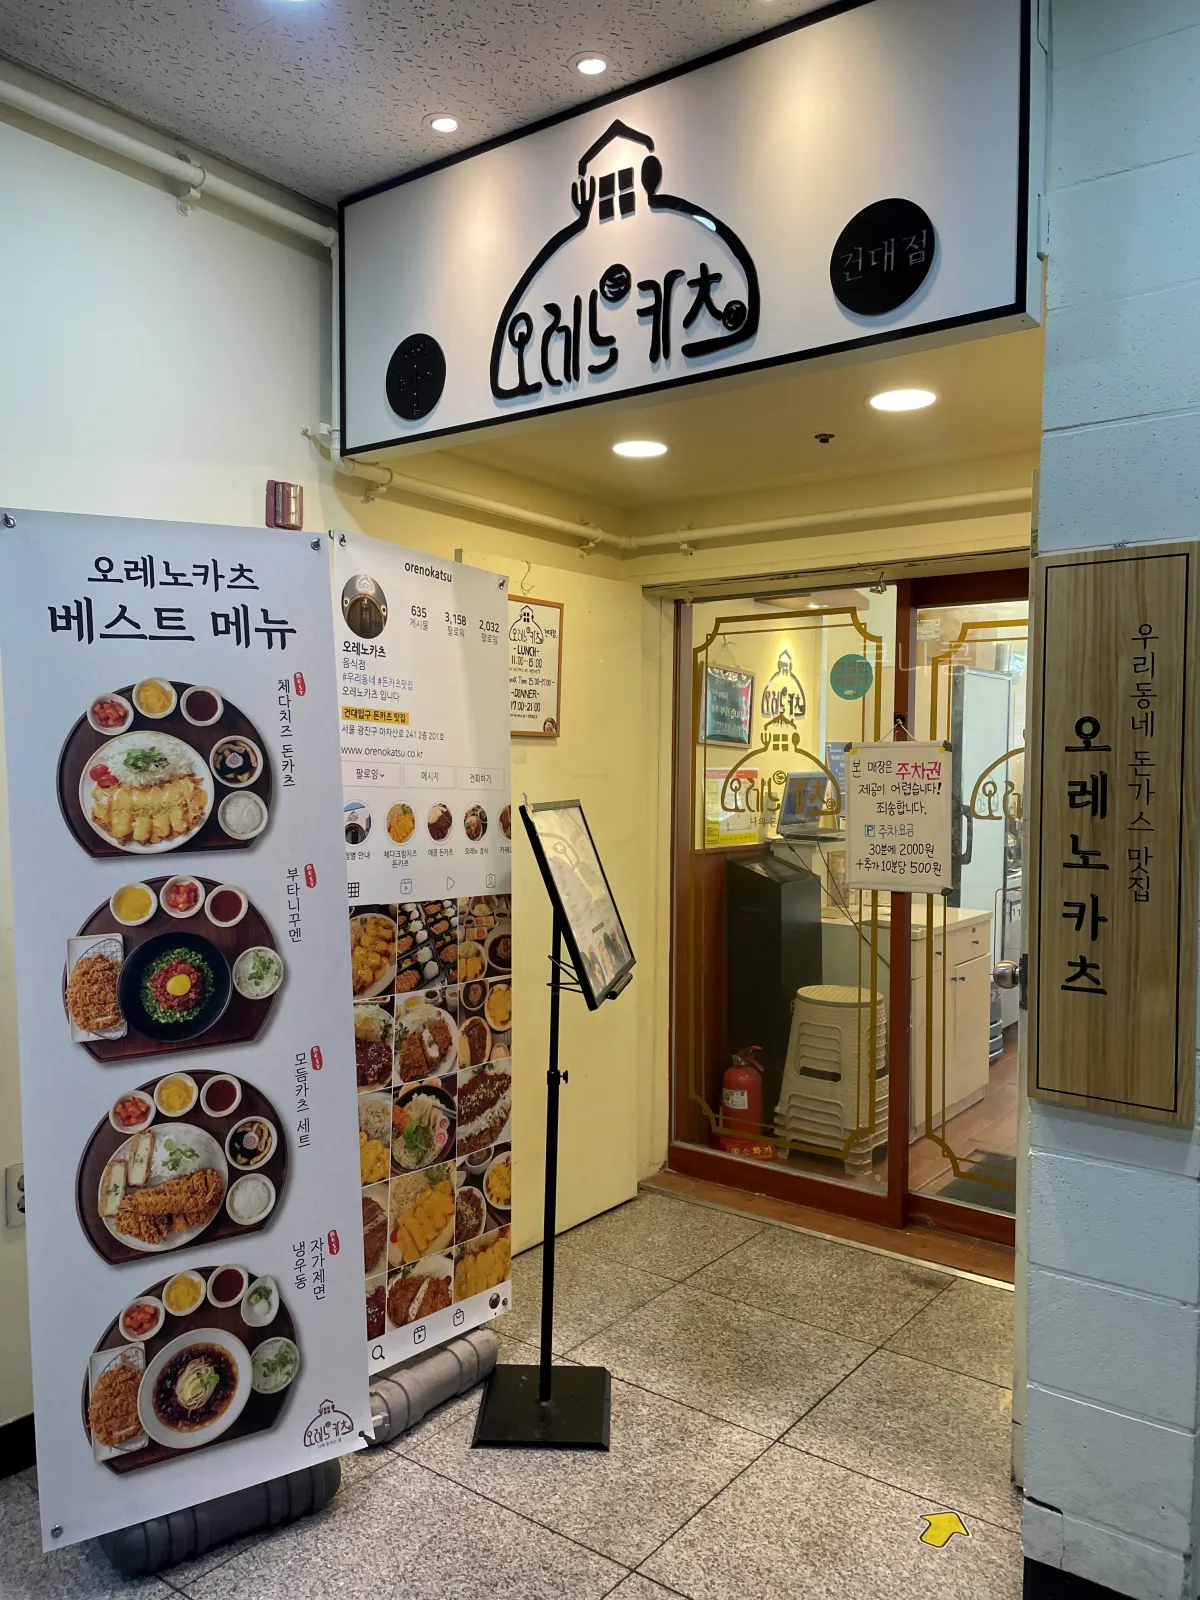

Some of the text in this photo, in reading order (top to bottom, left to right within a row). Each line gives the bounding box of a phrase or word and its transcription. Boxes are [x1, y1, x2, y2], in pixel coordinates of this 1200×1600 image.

[838, 227, 929, 283] 건대점
[87, 554, 260, 591] 오레노카츠
[404, 562, 452, 583] orenokatsu
[411, 605, 427, 618] 635
[444, 611, 467, 626] 3,158
[47, 596, 298, 650] 베스트 메뉴
[479, 619, 500, 633] 2,032
[342, 640, 386, 658] 오레노카츠
[342, 657, 366, 670] 음식점
[295, 672, 304, 695] BEST
[342, 672, 376, 686] #우리동네
[342, 686, 400, 702] 오레노카츠 입니다
[344, 708, 406, 723] 건대입구 돈카츠 맛집
[277, 679, 296, 787] 체다치즈 돈카츠
[341, 724, 355, 735] 서울
[357, 725, 377, 736] 광진구
[405, 730, 416, 738] 241
[341, 746, 423, 758] www.orenokatsu.co.kr
[852, 758, 862, 778] 본
[867, 759, 893, 774] 매장은
[895, 761, 942, 780] 주차권
[1126, 622, 1159, 902] 우리동네 돈가스 맛집
[356, 768, 379, 779] 팔로잉
[858, 781, 942, 797] 제공이 어렵습니다!
[876, 800, 927, 816] 죄송합니다.
[878, 823, 915, 839] 주차요금
[868, 843, 934, 858] 30분에 2000원
[1060, 715, 1113, 996] 오레노카츠
[306, 864, 315, 888] BEST
[881, 860, 907, 874] 10분당
[909, 861, 942, 876] 500원
[286, 867, 302, 943] 부타니꾸멘
[294, 1052, 311, 1148] 모듬카츠 세트
[292, 1241, 308, 1290] 냉우동
[310, 1237, 325, 1300] 자가제면
